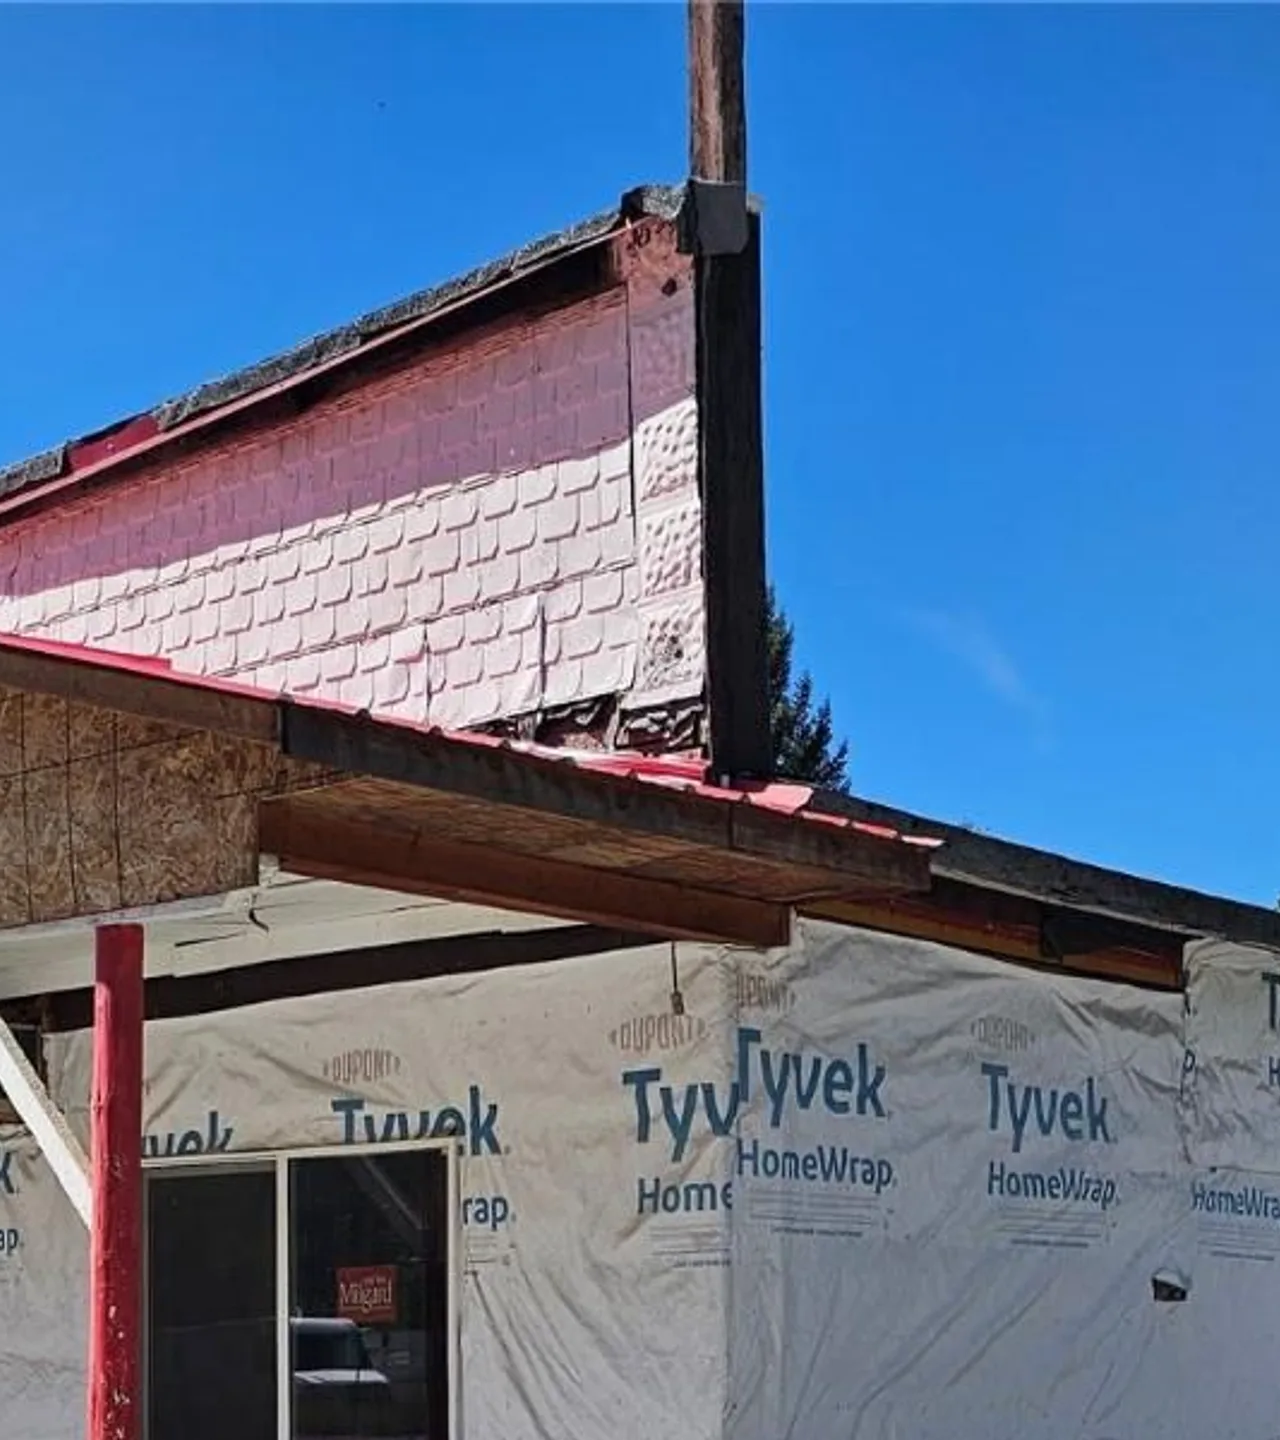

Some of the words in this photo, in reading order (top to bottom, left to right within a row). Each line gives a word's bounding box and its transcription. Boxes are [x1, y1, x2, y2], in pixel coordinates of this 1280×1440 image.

[622, 1068, 738, 1162] Tyv
[736, 1027, 886, 1128] Tyvek
[980, 1062, 1110, 1152] Tyvek
[737, 1138, 893, 1193] HomeWrap
[988, 1162, 1116, 1210] HomeWrap
